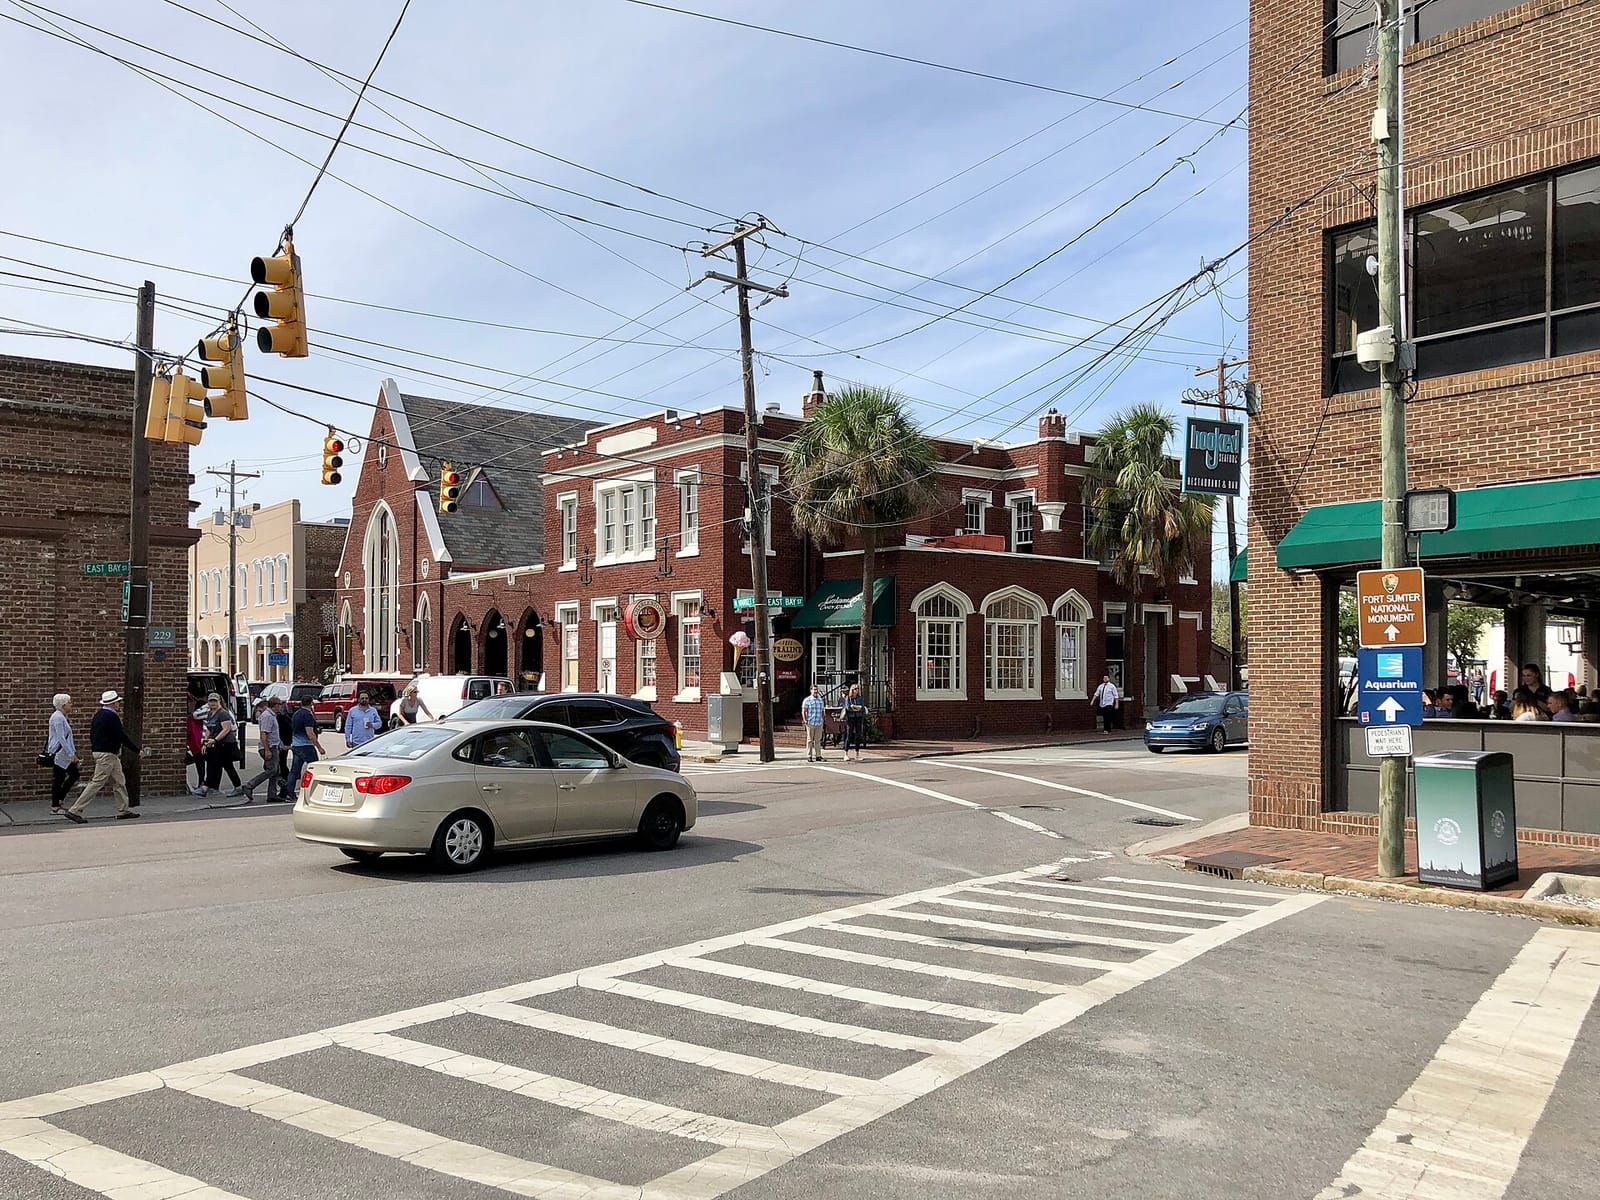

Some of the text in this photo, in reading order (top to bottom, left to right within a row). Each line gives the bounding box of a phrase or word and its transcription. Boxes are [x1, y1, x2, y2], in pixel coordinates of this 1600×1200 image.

[1190, 425, 1240, 469] hooked
[1187, 477, 1220, 487] RESTAURANT
[86, 564, 104, 573] EAST
[108, 563, 121, 572] BAY
[767, 598, 783, 606] EAST
[785, 598, 796, 606] BAY
[1362, 592, 1420, 605] FORT SUMTER
[1370, 603, 1412, 614] NATIONAL
[1367, 613, 1415, 624] MONUMENT
[154, 631, 171, 640] 229
[1365, 680, 1417, 690] Aquarium
[1371, 729, 1405, 737] PEDESTRIANS
